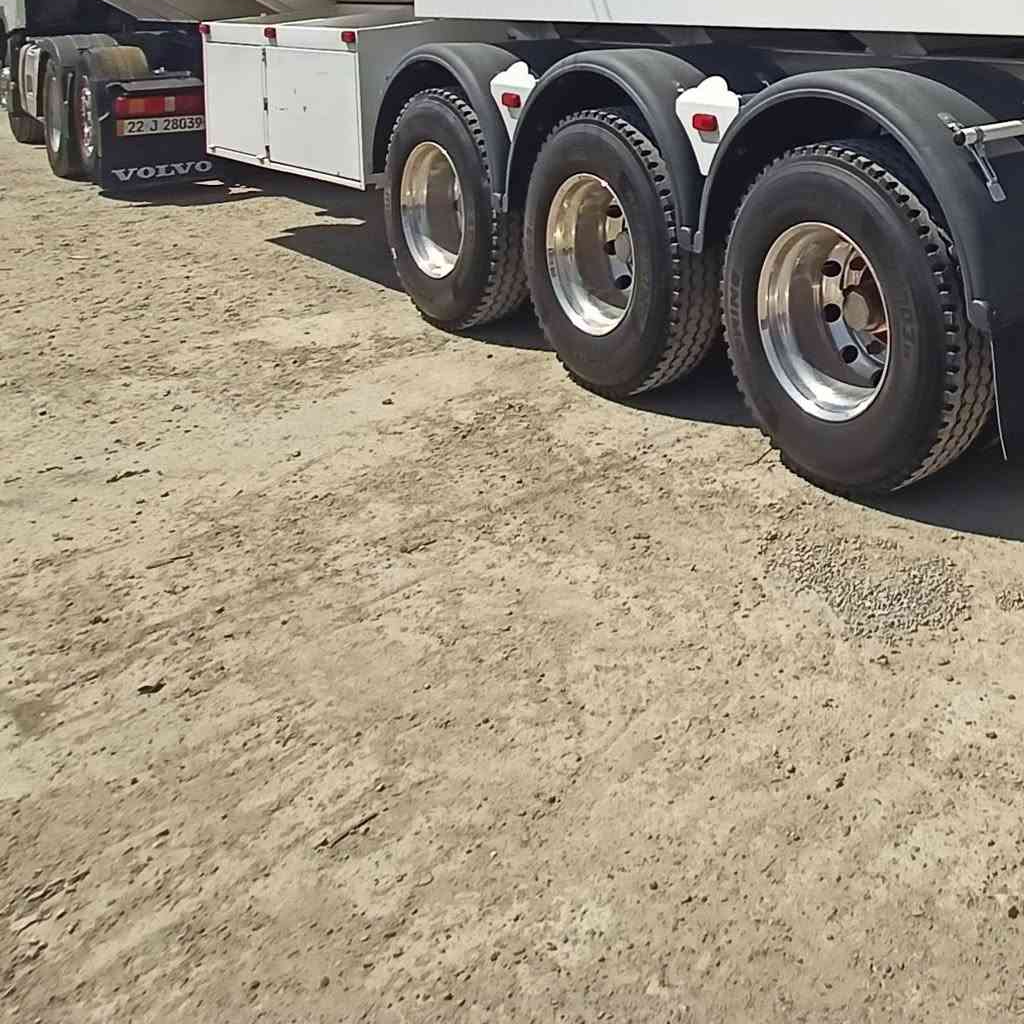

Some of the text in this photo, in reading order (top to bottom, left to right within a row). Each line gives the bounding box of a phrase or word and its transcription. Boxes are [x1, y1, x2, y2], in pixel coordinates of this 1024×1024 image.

[127, 117, 202, 133] 22 J 28039
[112, 161, 212, 181] VOLVO
